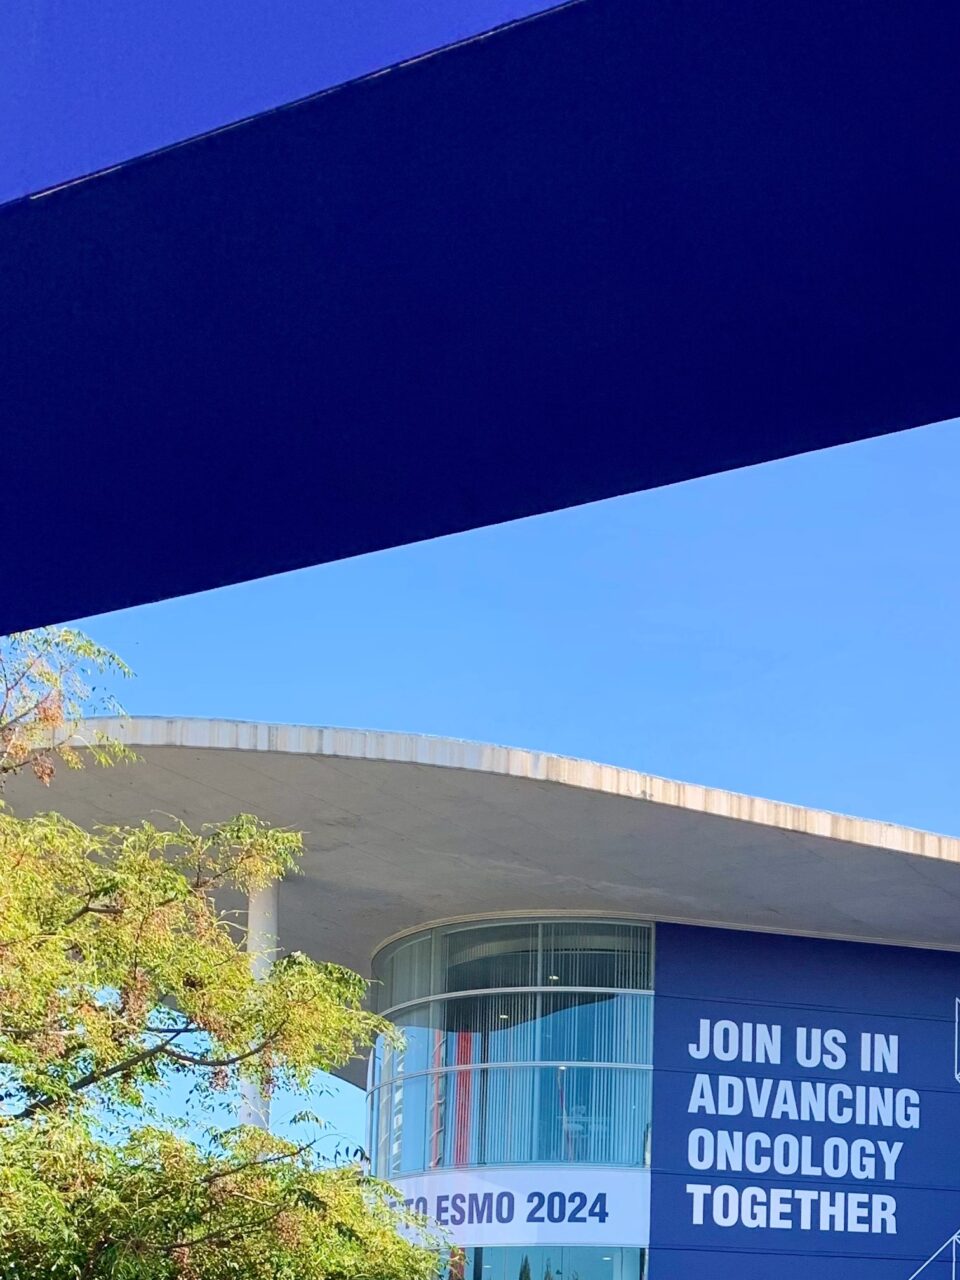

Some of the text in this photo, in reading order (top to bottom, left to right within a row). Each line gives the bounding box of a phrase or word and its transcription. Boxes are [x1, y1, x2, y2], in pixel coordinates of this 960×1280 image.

[688, 1018, 899, 1074] JOIN US IN
[687, 1073, 920, 1129] ADVANCING
[687, 1127, 904, 1181] ONCOLOGY
[436, 1191, 515, 1226] ESMO
[526, 1191, 609, 1224] 2024
[686, 1183, 898, 1235] TOGETHER
